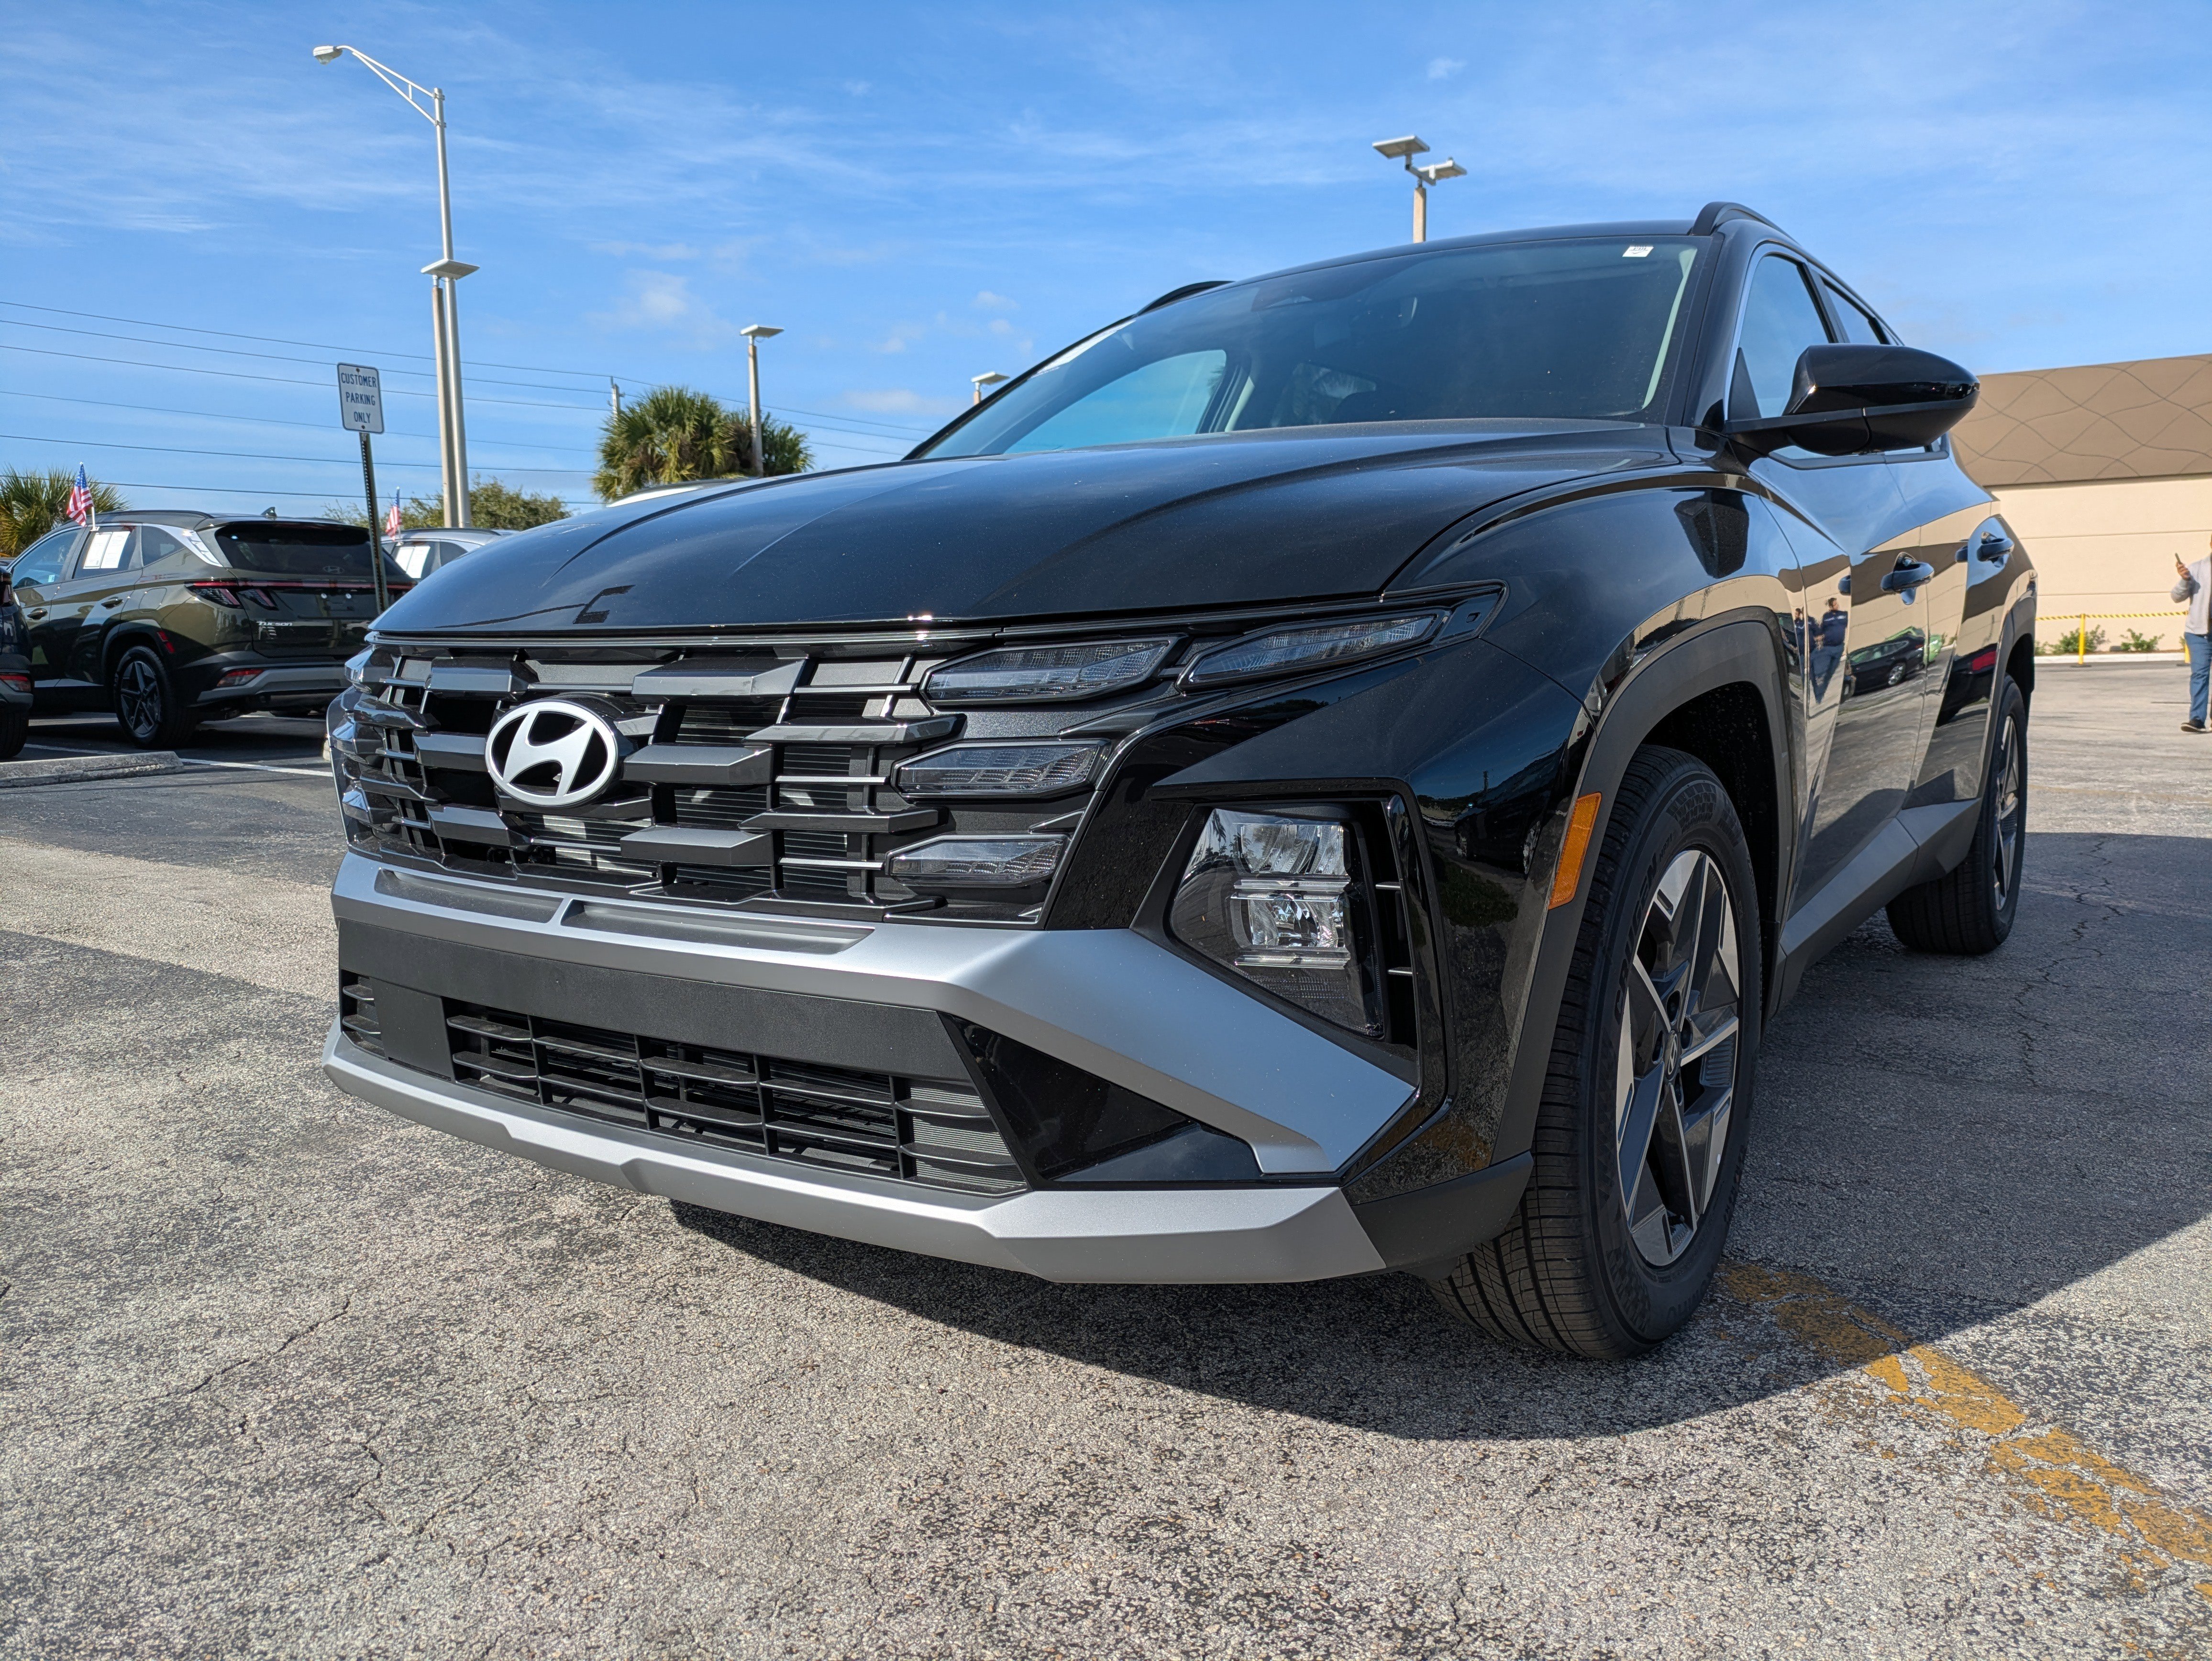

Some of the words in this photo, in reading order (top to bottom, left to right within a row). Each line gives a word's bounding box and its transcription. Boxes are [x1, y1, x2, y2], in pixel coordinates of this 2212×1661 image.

[341, 373, 377, 388] CUSTOMER
[346, 392, 376, 406] PARKING
[354, 411, 371, 423] ONLY
